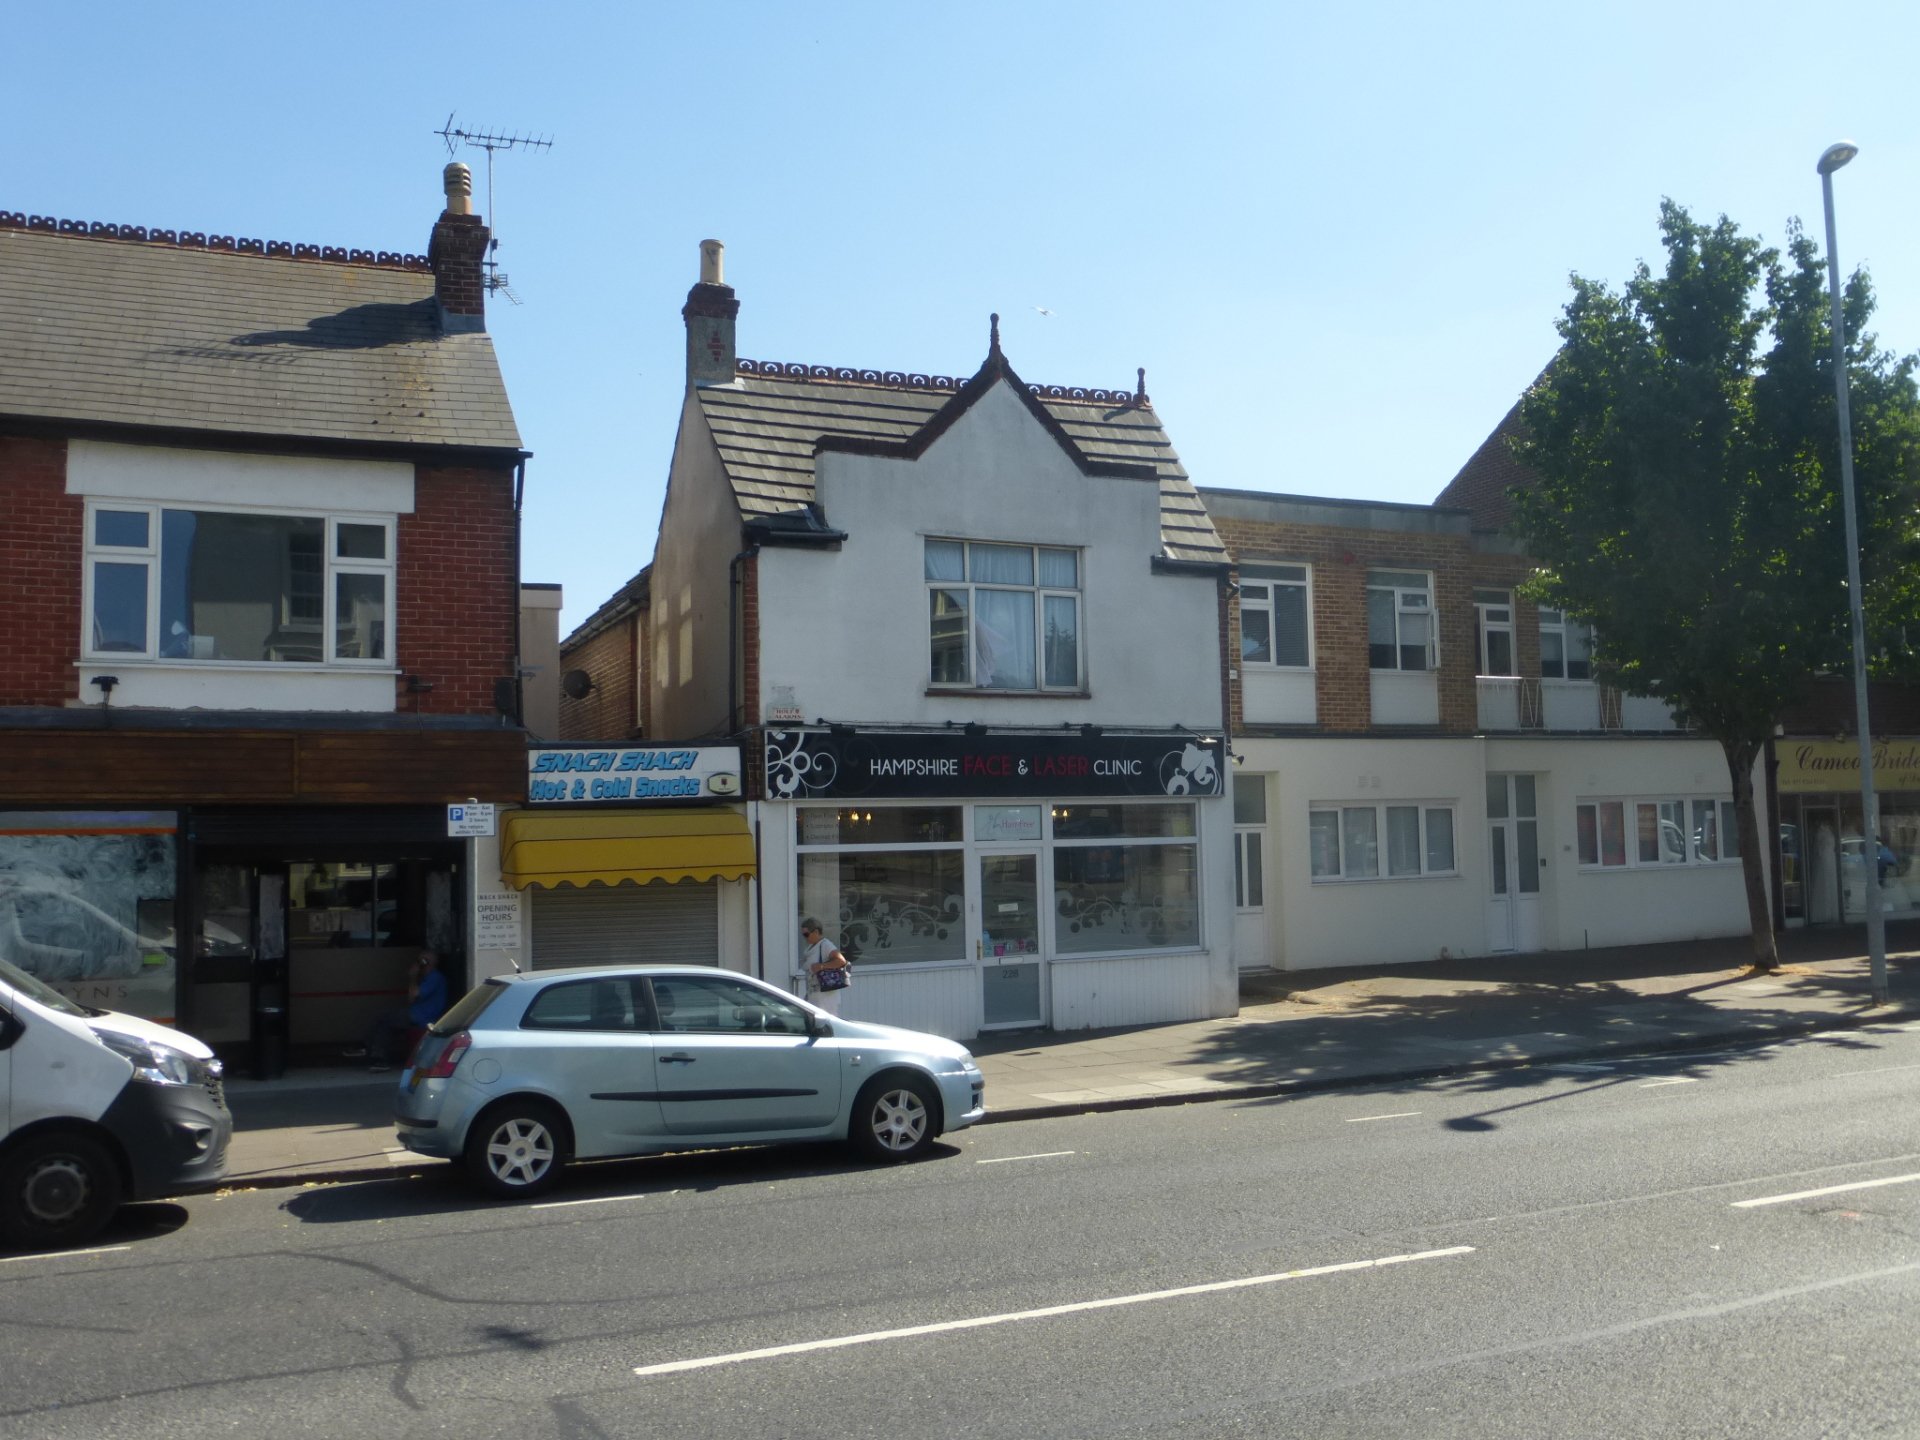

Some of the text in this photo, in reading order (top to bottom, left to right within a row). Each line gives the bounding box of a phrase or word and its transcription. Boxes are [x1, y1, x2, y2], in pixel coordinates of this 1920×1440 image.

[1796, 745, 1861, 770] Cameo
[870, 756, 1143, 776] HAMPSHIRE FACE & LASER CLINIC
[530, 776, 700, 801] Hot & Cold Snacks
[453, 809, 461, 820] P
[477, 904, 517, 912] OPENING
[482, 913, 512, 921] HOURS
